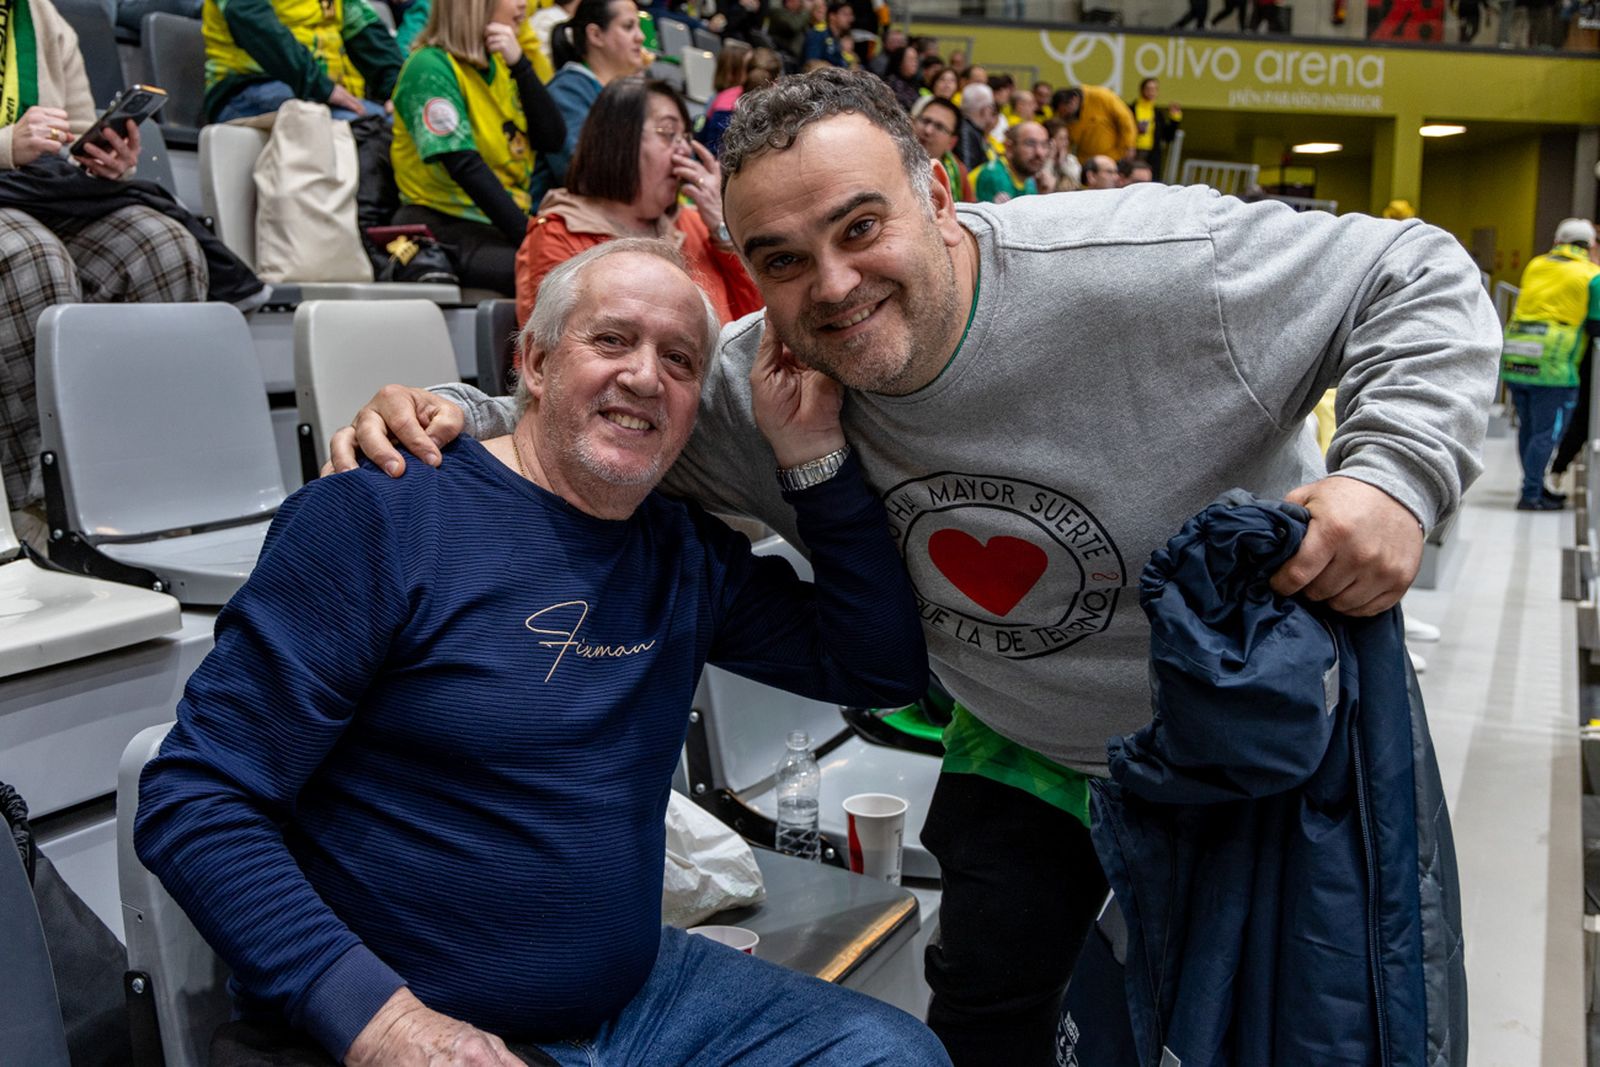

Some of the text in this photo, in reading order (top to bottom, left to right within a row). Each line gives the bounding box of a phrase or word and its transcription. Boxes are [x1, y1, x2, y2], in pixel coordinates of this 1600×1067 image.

[1135, 37, 1241, 81] olivo
[1254, 49, 1385, 88] arena
[928, 478, 1015, 505] MAYOR
[1030, 492, 1111, 560] SUERTE
[955, 620, 982, 648] LA
[996, 630, 1026, 652] DE
